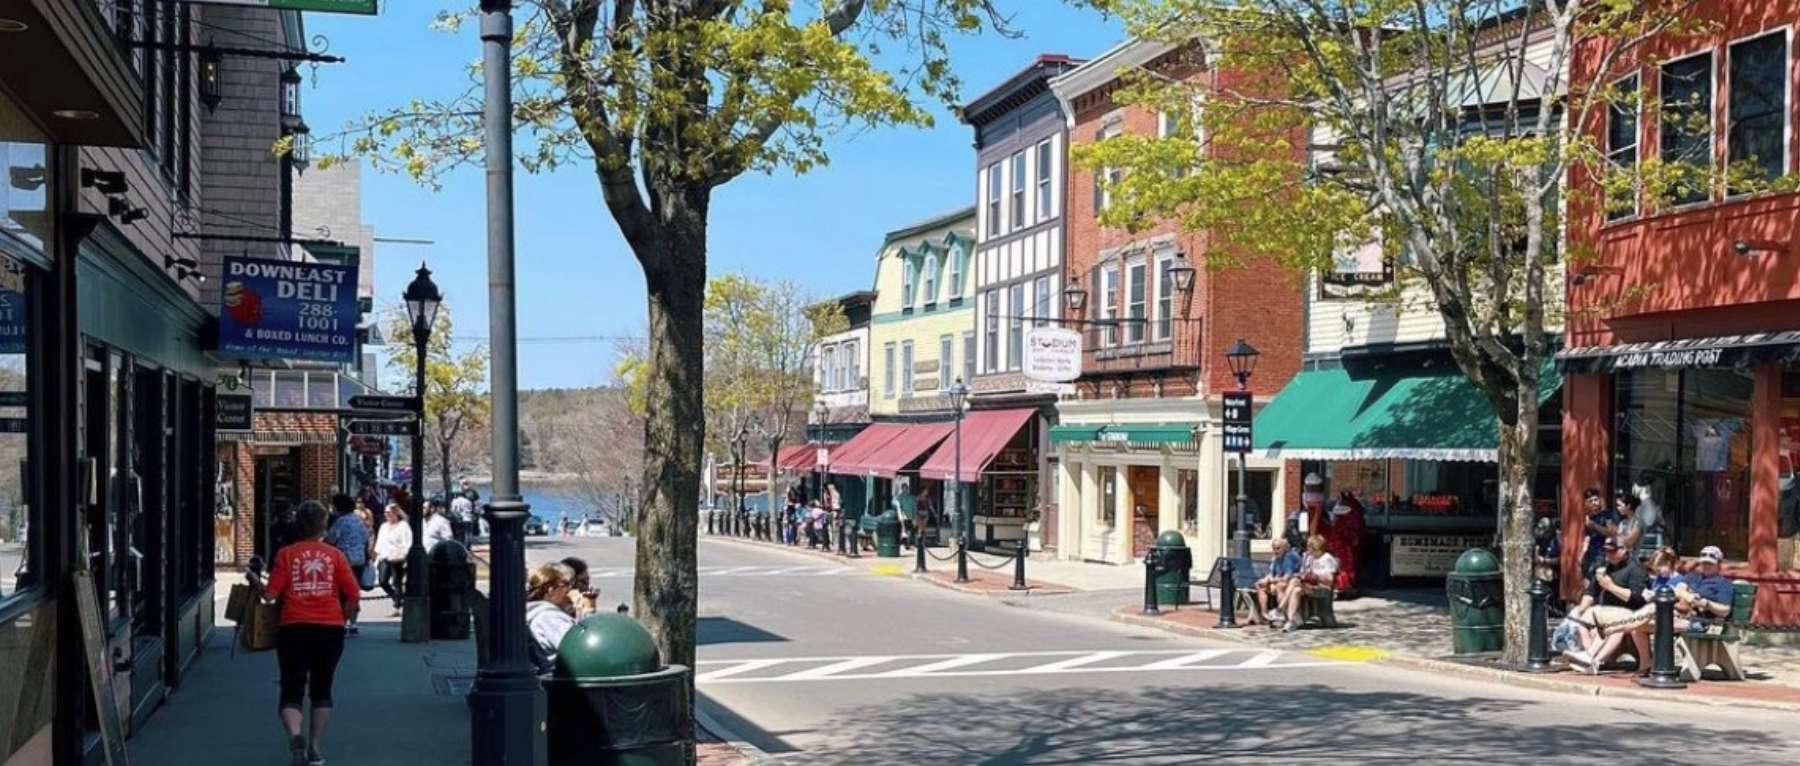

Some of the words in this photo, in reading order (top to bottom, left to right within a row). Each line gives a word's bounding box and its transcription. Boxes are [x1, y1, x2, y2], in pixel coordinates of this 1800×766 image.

[230, 262, 346, 283] DOWNEAST
[1353, 272, 1384, 281] CREAM
[277, 280, 338, 302] DELI
[298, 302, 338, 317] 288-
[298, 316, 338, 331] 1001
[245, 329, 253, 339] &
[256, 329, 292, 341] BOXED
[295, 332, 329, 344] LUNCH
[332, 335, 349, 346] CO.
[1030, 336, 1077, 348] STDIUM
[1650, 351, 1694, 365] TRADING
[1695, 348, 1722, 363] POST
